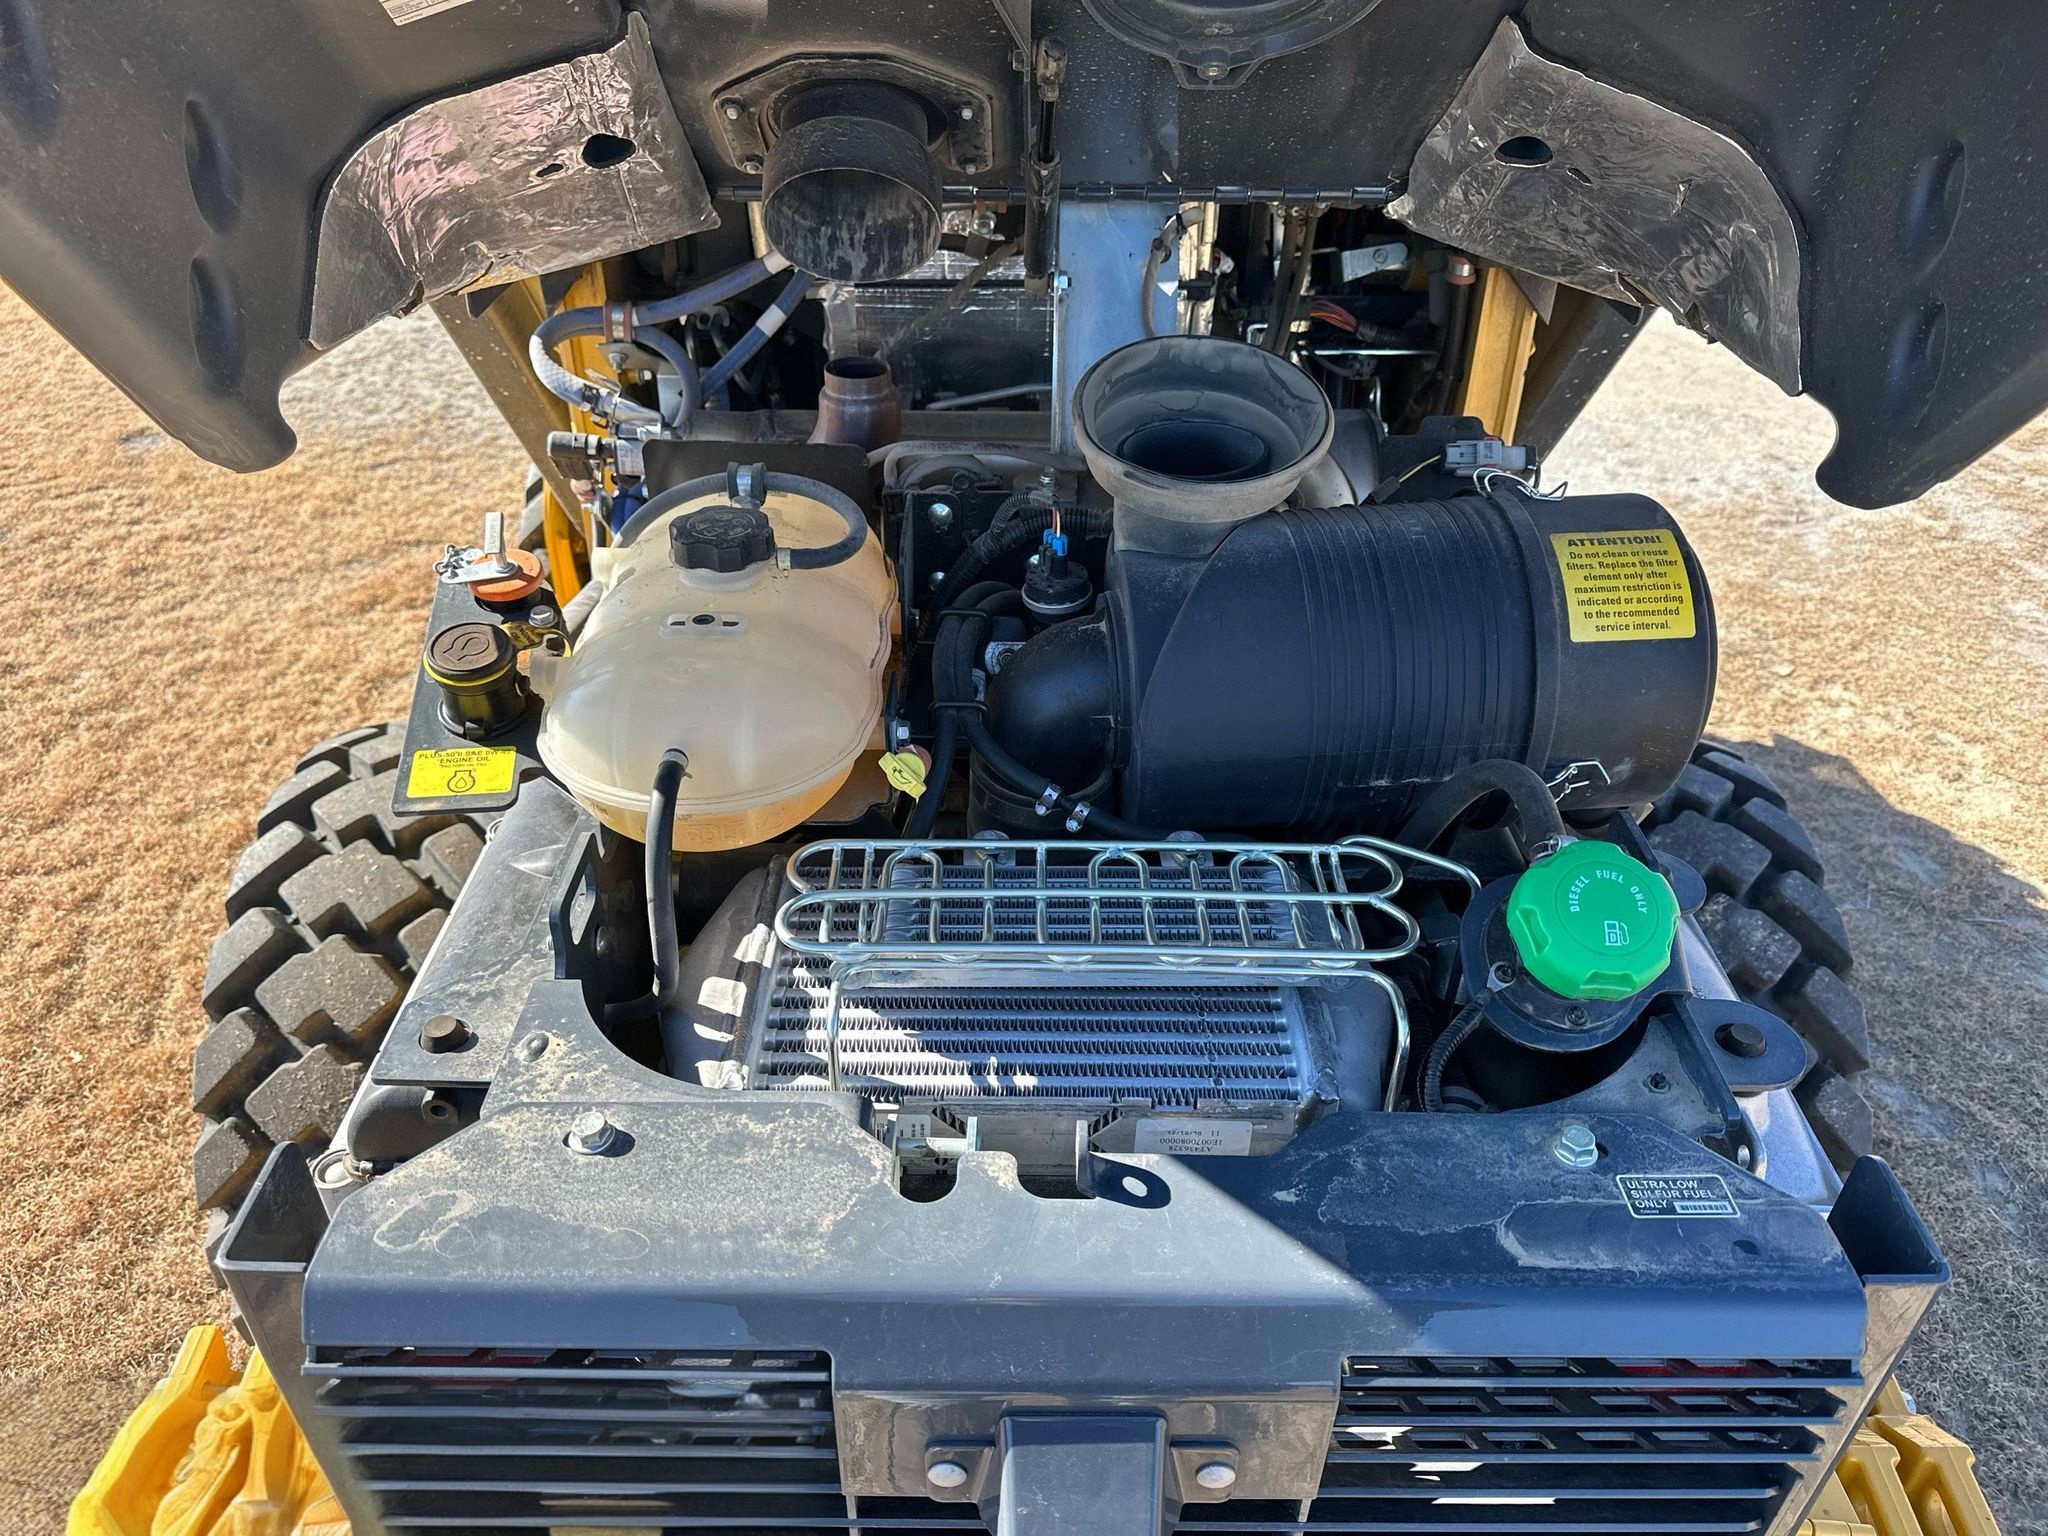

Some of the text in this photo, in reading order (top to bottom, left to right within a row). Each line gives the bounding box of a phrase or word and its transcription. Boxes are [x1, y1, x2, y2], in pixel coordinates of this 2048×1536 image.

[1567, 535, 1663, 547] ATTENTION!
[1569, 551, 1583, 560] Do
[1585, 551, 1600, 559] not
[1602, 550, 1629, 559] clean
[1642, 549, 1669, 557] reuse
[1566, 558, 1678, 571] filters. Replace the filter
[1583, 570, 1668, 582] element only after
[1574, 582, 1682, 594] maximum restriction is
[1577, 594, 1684, 607] indicated or according
[1584, 607, 1680, 619] to the recommended
[1595, 620, 1671, 632] service interval.
[465, 749, 483, 757] SAE
[1569, 869, 1648, 914] DIESEL FUEL ONLY
[1626, 1180, 1698, 1189] ULTRA LOW
[1630, 1190, 1717, 1199] SULFUR FUEL
[1635, 1200, 1668, 1208] ONLY
